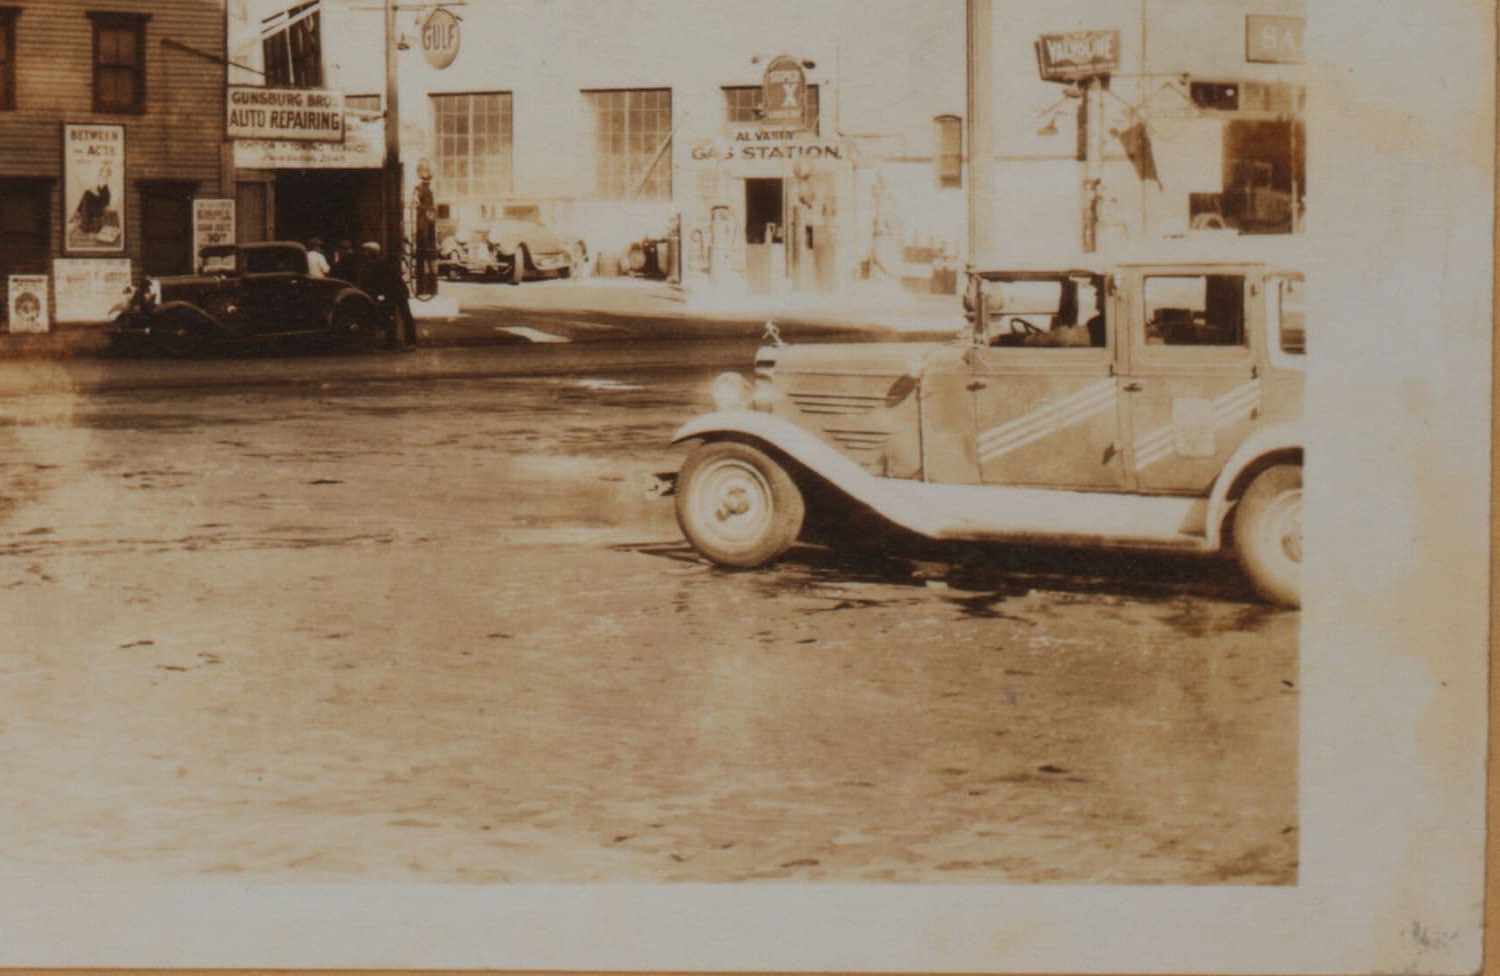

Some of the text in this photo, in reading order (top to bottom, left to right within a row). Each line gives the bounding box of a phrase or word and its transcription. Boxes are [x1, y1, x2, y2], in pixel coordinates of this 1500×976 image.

[423, 24, 456, 51] GULF
[231, 91, 303, 107] GUNSBURG
[230, 108, 339, 131] AUTO REPAIRING
[70, 130, 118, 141] BETWEEN
